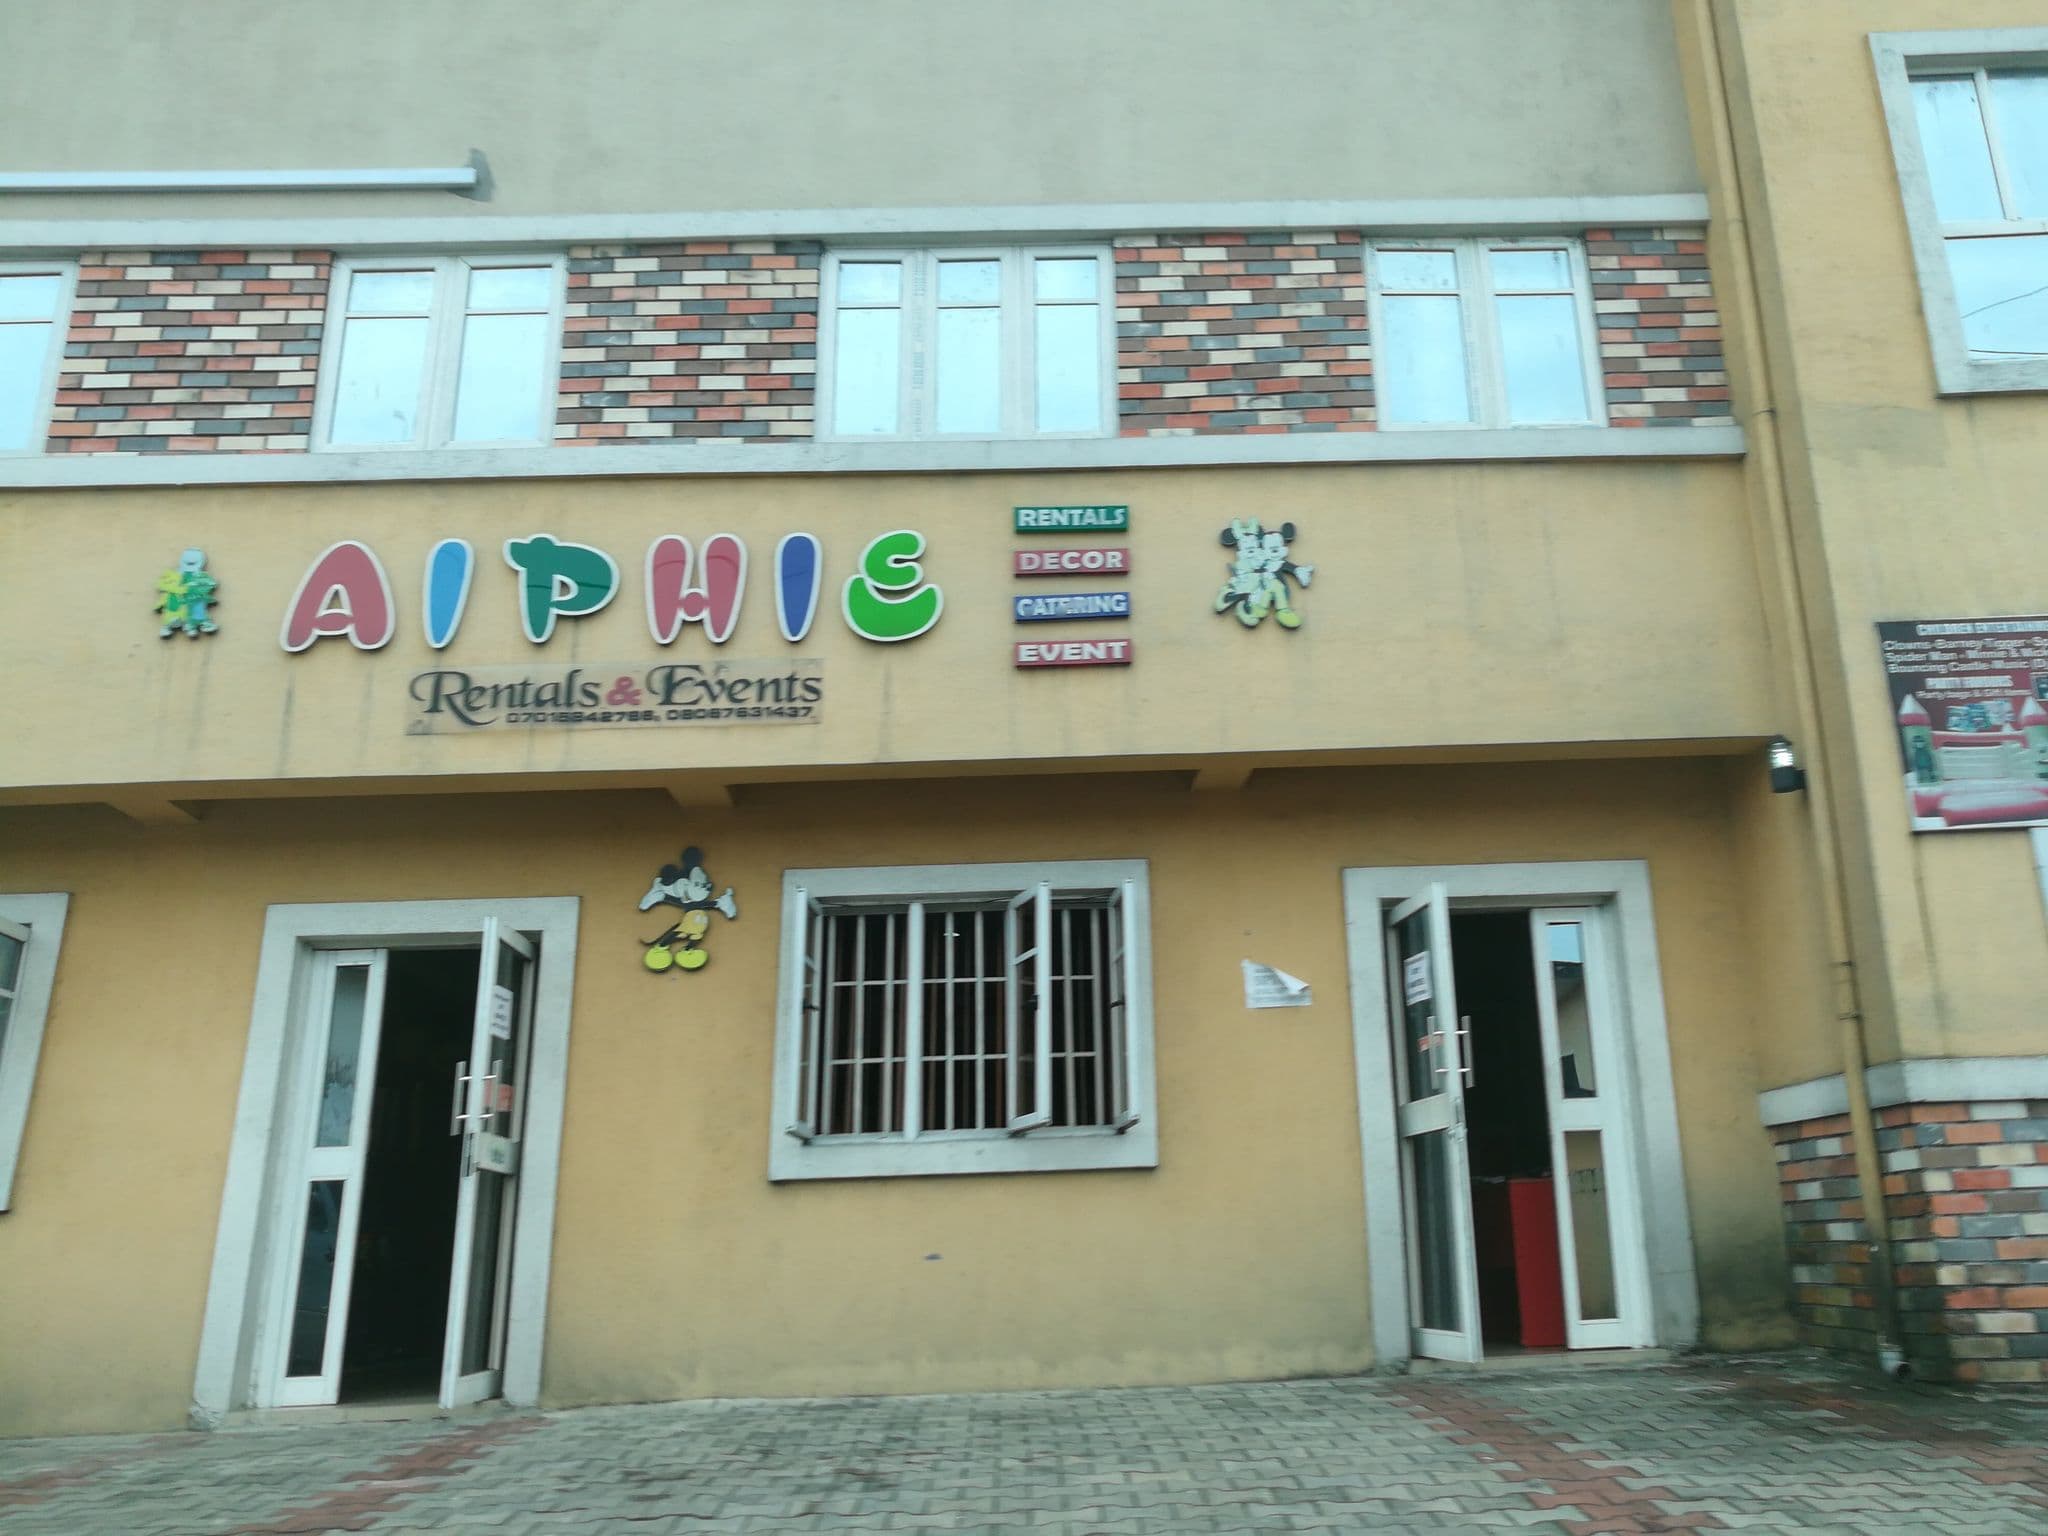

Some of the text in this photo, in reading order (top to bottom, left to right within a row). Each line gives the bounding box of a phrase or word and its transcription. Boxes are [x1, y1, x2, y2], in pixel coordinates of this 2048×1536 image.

[1018, 509, 1125, 526] RENTALS
[1019, 551, 1124, 570] DECOR
[1018, 642, 1128, 662] EVENT
[409, 664, 822, 726] Rentals & Events
